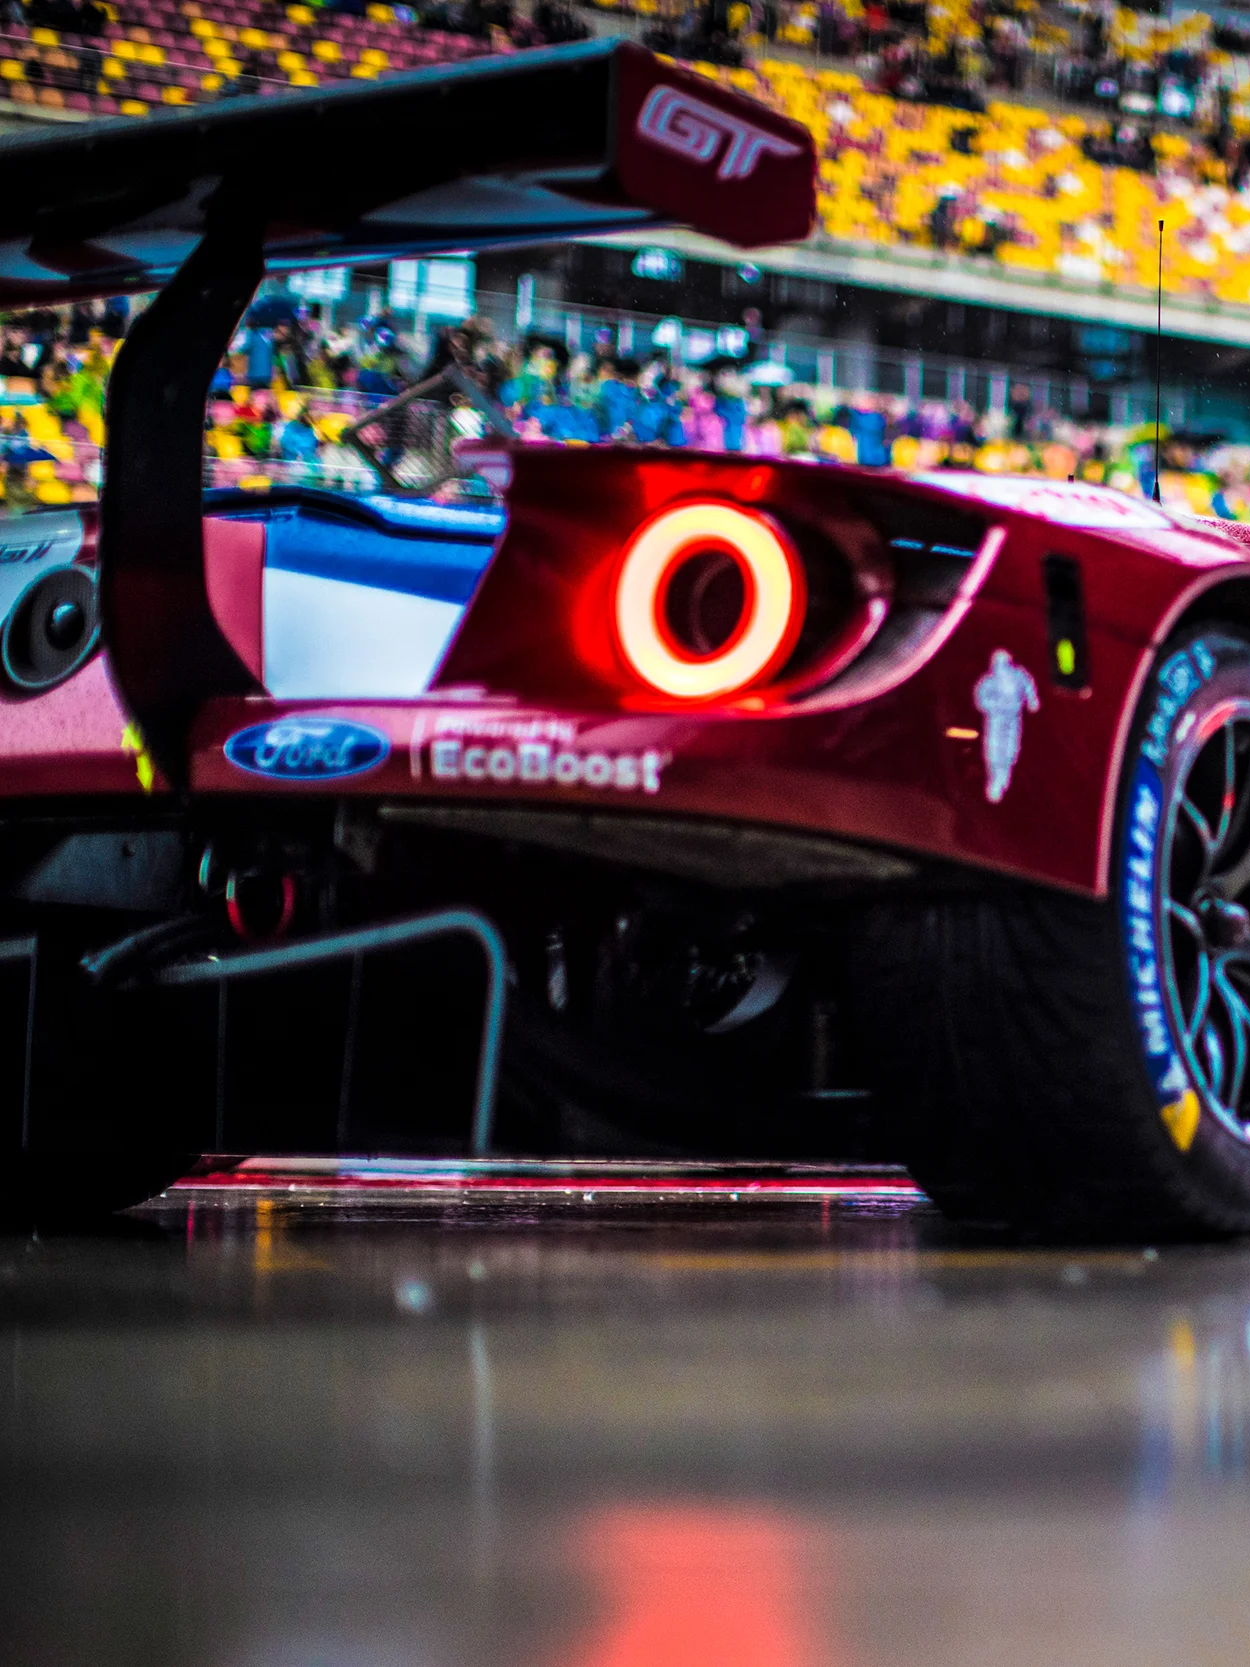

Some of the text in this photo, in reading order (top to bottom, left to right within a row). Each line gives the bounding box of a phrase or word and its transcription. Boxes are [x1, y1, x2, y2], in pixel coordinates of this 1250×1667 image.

[637, 84, 803, 180] GT
[254, 723, 360, 769] Ford
[1127, 784, 1169, 1056] MICHELIN
